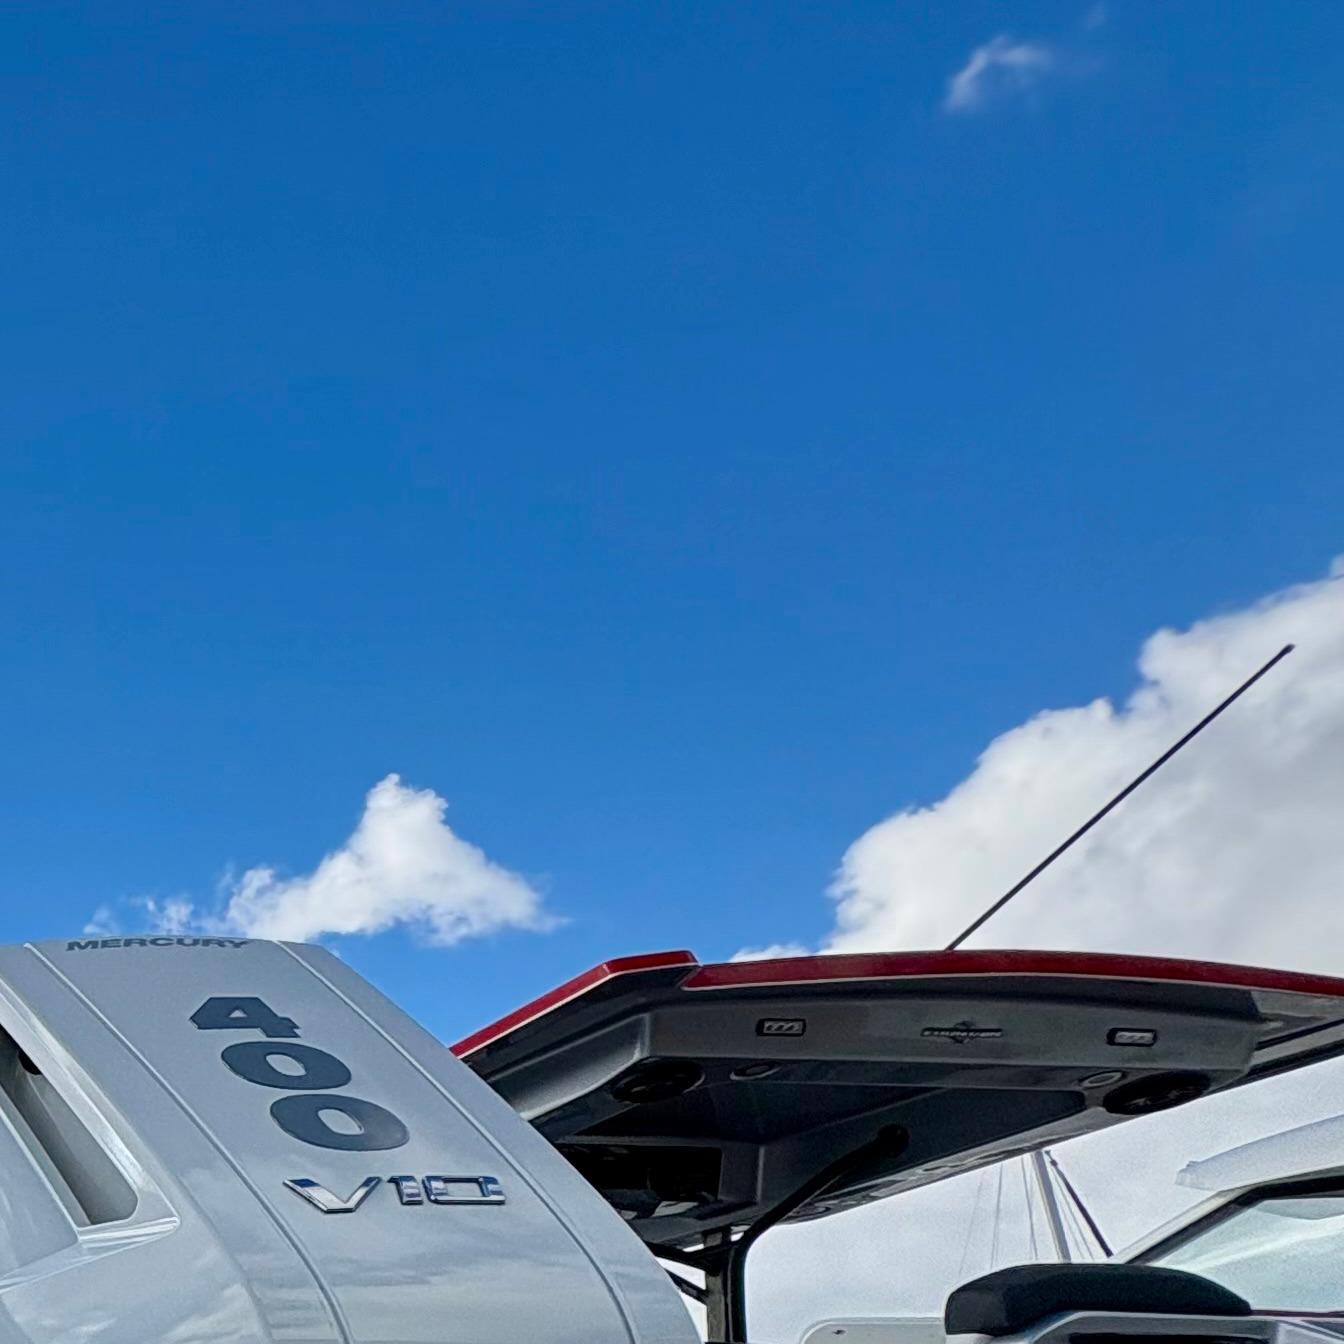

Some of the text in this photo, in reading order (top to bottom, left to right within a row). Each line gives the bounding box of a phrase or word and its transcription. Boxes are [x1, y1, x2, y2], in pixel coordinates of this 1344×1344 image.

[66, 936, 249, 952] MERCURY
[188, 996, 411, 1152] 400
[282, 1174, 507, 1214] V10
